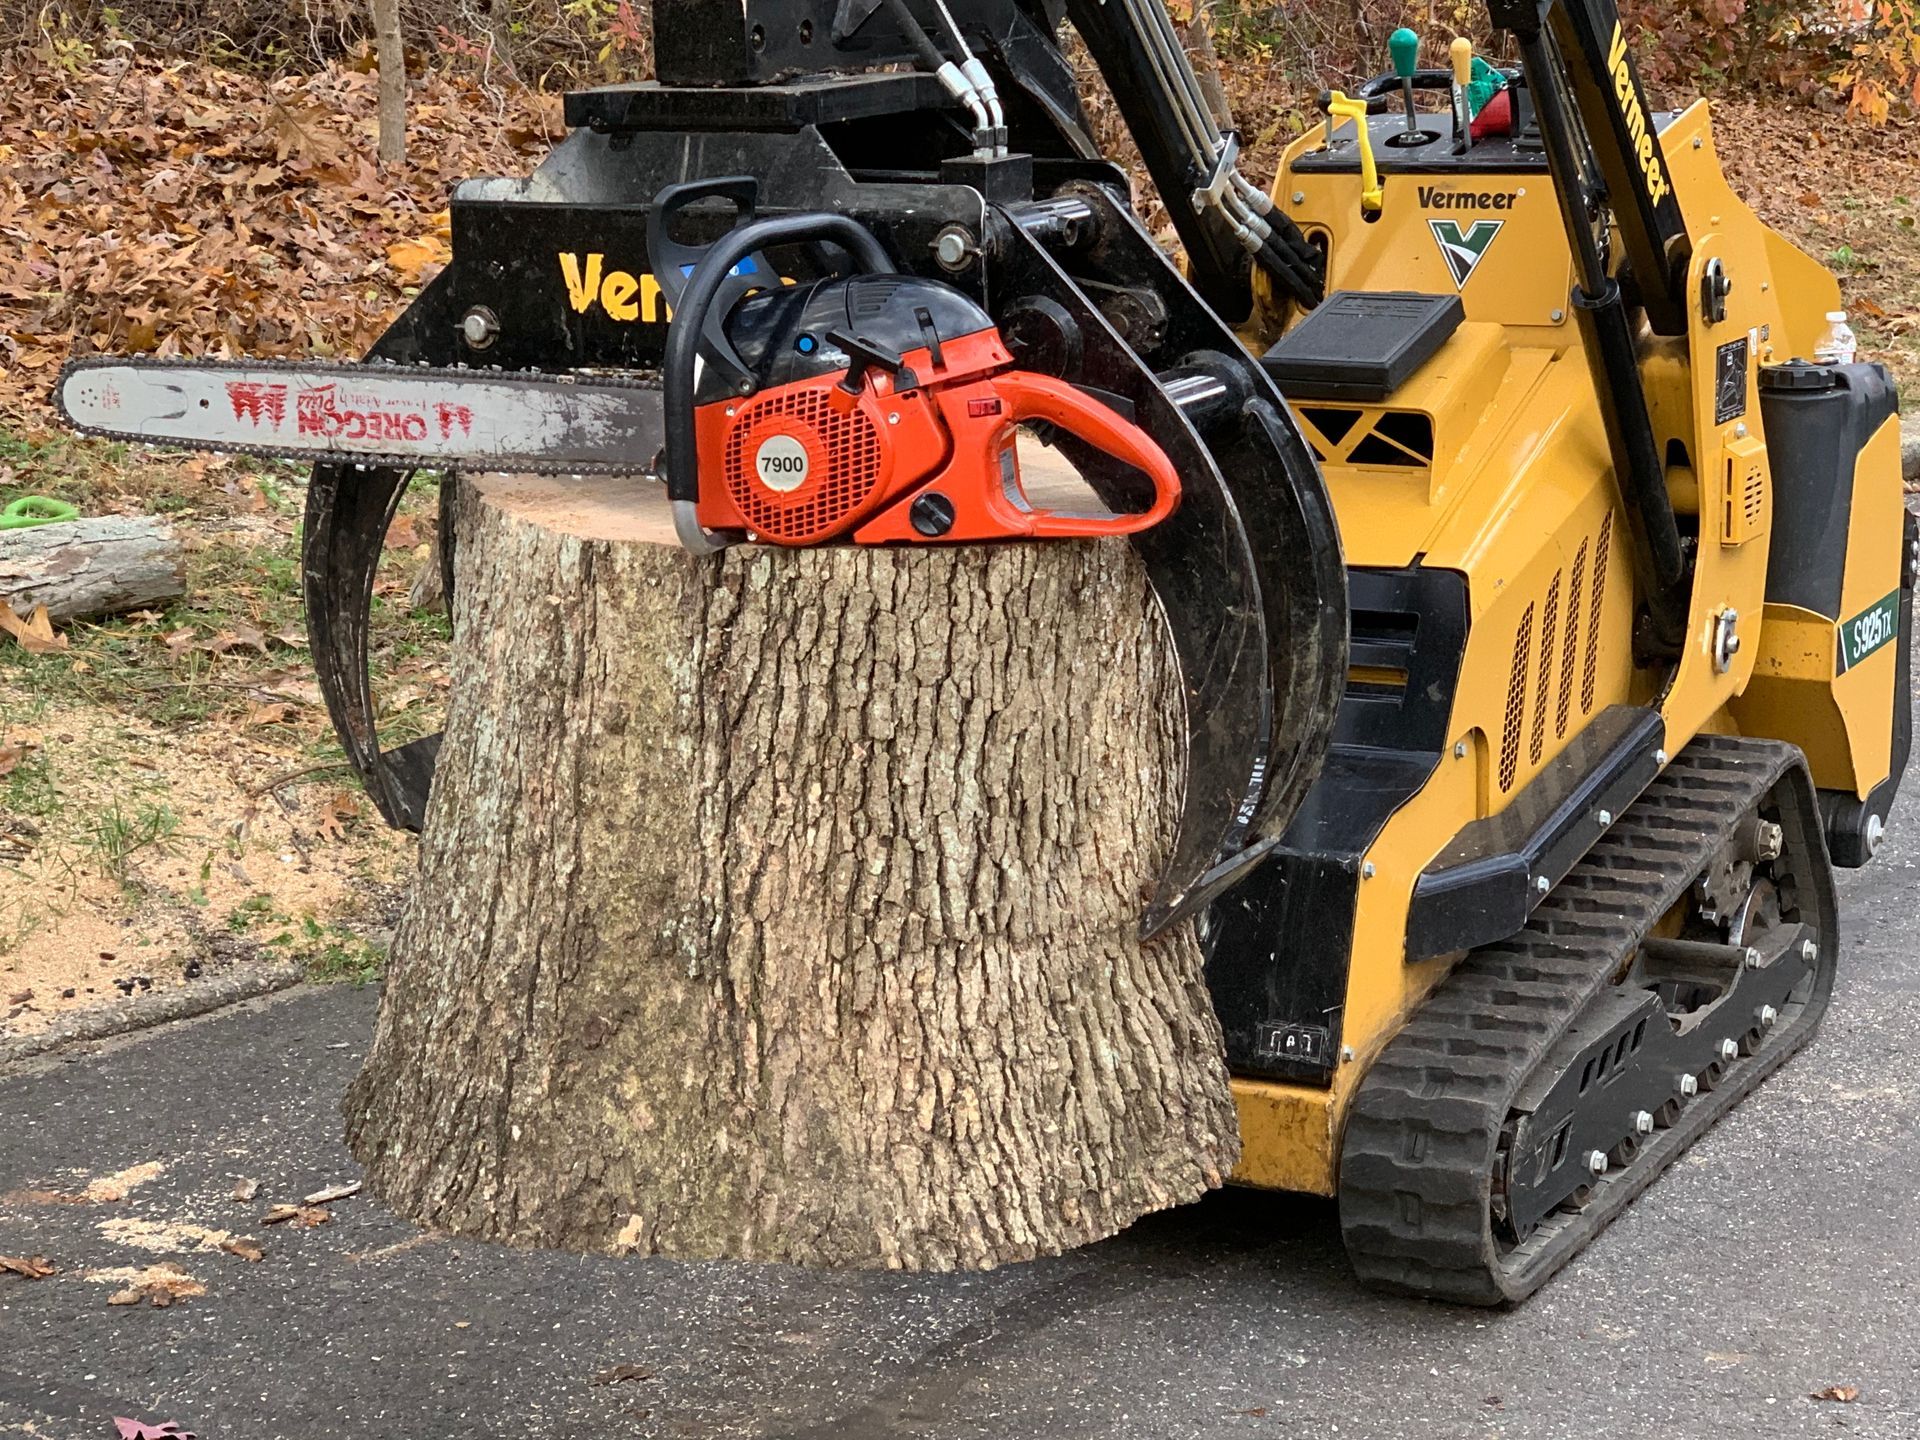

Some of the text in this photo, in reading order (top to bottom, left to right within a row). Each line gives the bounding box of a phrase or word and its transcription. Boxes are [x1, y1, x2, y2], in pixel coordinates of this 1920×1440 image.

[1607, 18, 1666, 208] Vermeer
[1417, 186, 1517, 209] Vermeer
[296, 391, 336, 412] Plus
[297, 410, 428, 441] OREGON
[761, 456, 803, 473] 7900
